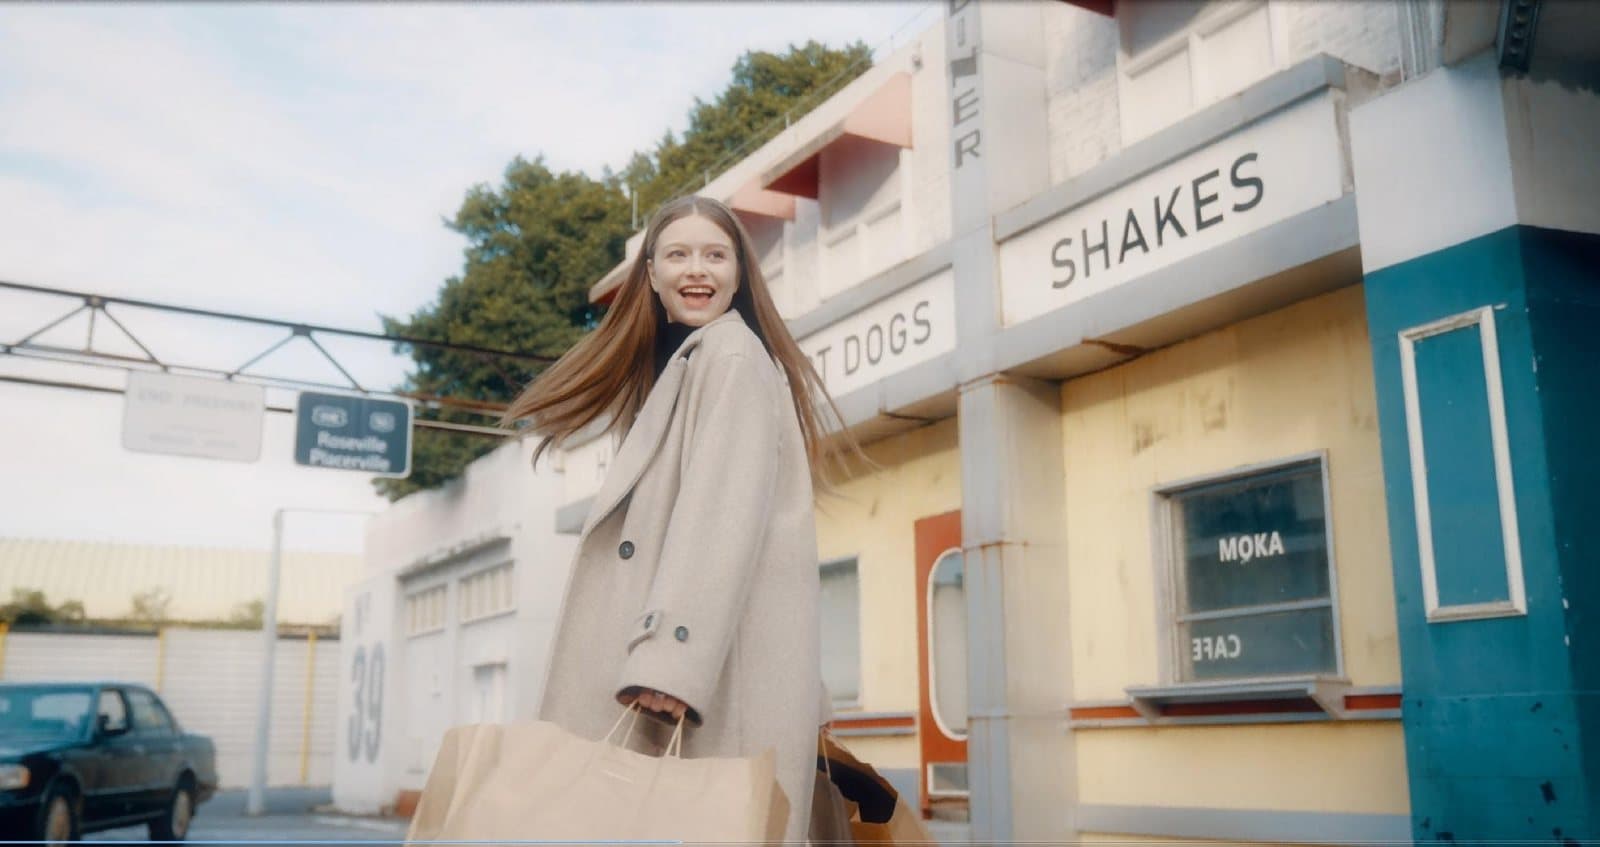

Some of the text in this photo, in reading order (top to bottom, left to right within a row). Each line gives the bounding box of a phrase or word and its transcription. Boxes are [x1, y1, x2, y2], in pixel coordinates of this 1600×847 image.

[1051, 152, 1264, 289] SHAKES
[844, 300, 932, 376] DOGS
[310, 448, 390, 472] Placerville
[317, 430, 388, 454] Roseville
[348, 643, 384, 764] 39
